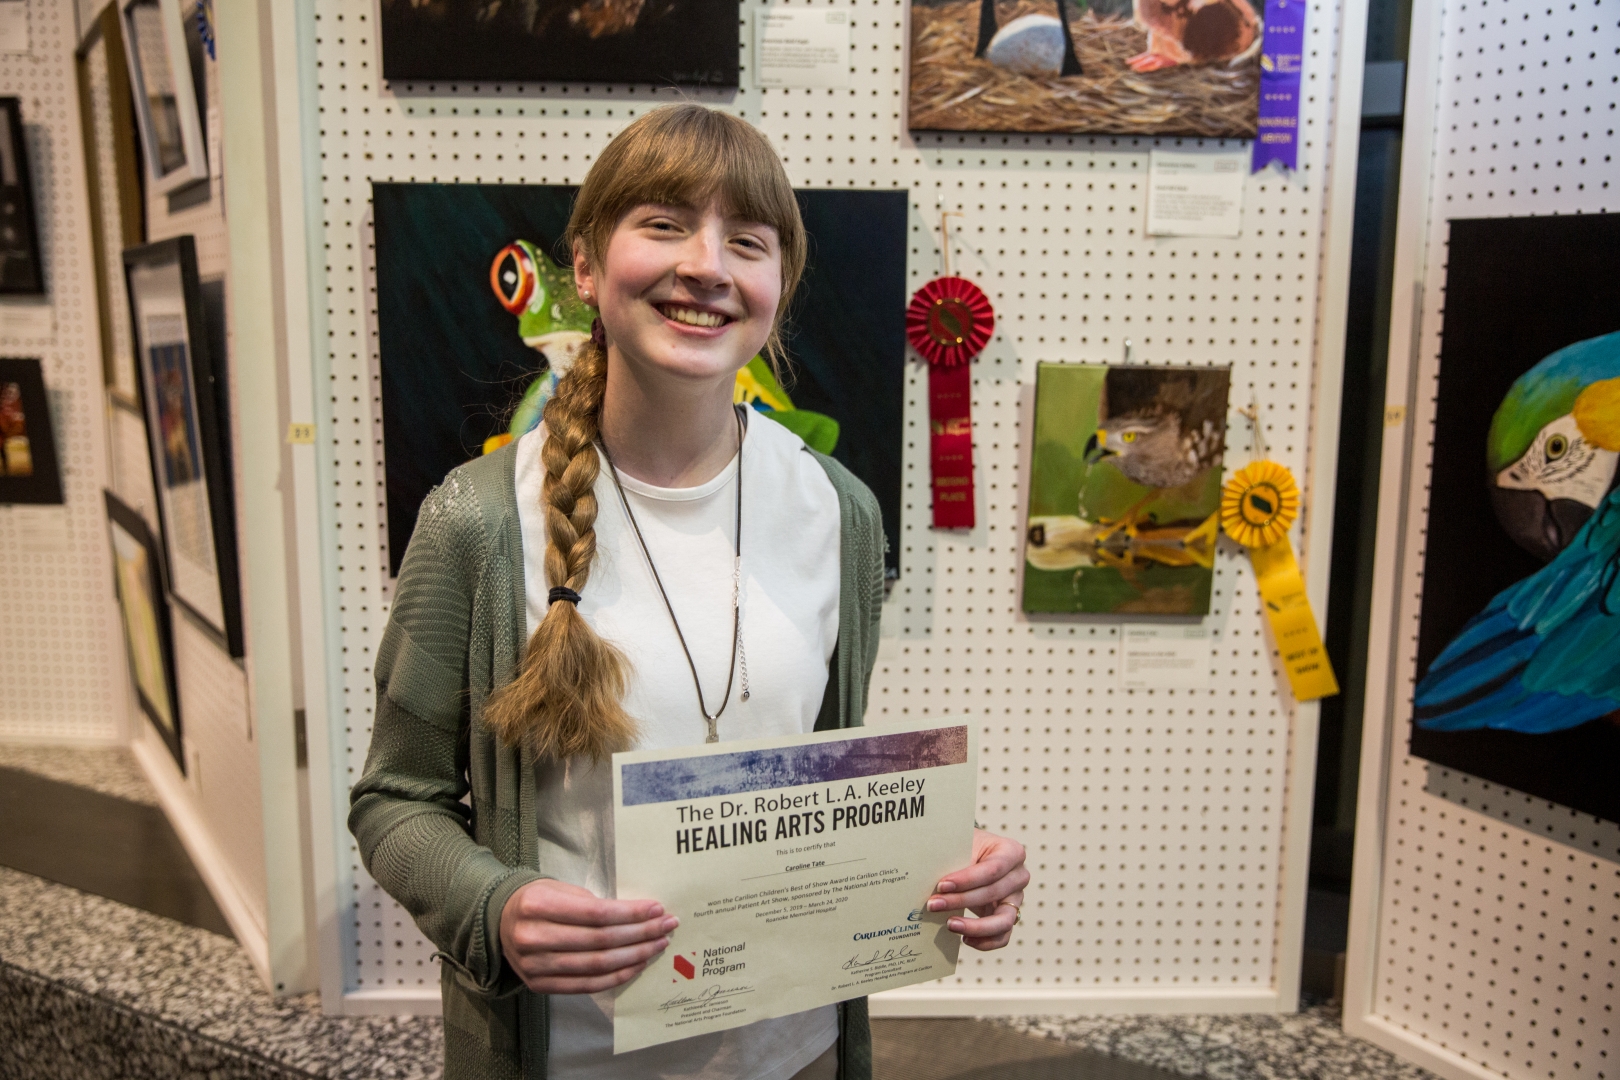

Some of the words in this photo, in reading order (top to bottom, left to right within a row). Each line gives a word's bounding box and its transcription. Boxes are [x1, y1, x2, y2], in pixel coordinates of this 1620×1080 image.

[676, 804, 714, 823] The
[720, 801, 748, 818] Dr.
[754, 792, 819, 814] Robert
[868, 777, 926, 798] Keeley
[676, 818, 767, 854] HEALING
[774, 810, 826, 840] ARTS
[832, 795, 925, 831] PROGRAM
[776, 848, 788, 856] This
[804, 841, 822, 852] certify
[785, 862, 810, 872] Caroline
[812, 860, 825, 868] Tate
[734, 893, 758, 902] Carilion
[759, 887, 789, 897] Children's
[830, 876, 848, 885] Award
[856, 872, 878, 880] Carilion
[879, 868, 898, 876] Clinic's
[693, 910, 714, 918] fourth
[714, 905, 736, 914] annual
[738, 901, 759, 910] Patient
[771, 895, 789, 904] Show,
[791, 890, 822, 901] sponsored
[844, 882, 868, 891] National
[755, 909, 782, 918] December
[766, 915, 788, 923] Roanoke
[790, 910, 815, 918] Memorial
[816, 906, 837, 914] Hospital
[888, 931, 921, 941] FOUNDATION
[703, 942, 746, 958] National
[702, 957, 724, 968] Arts
[702, 962, 746, 977] Program
[722, 1008, 746, 1016] Foundation
